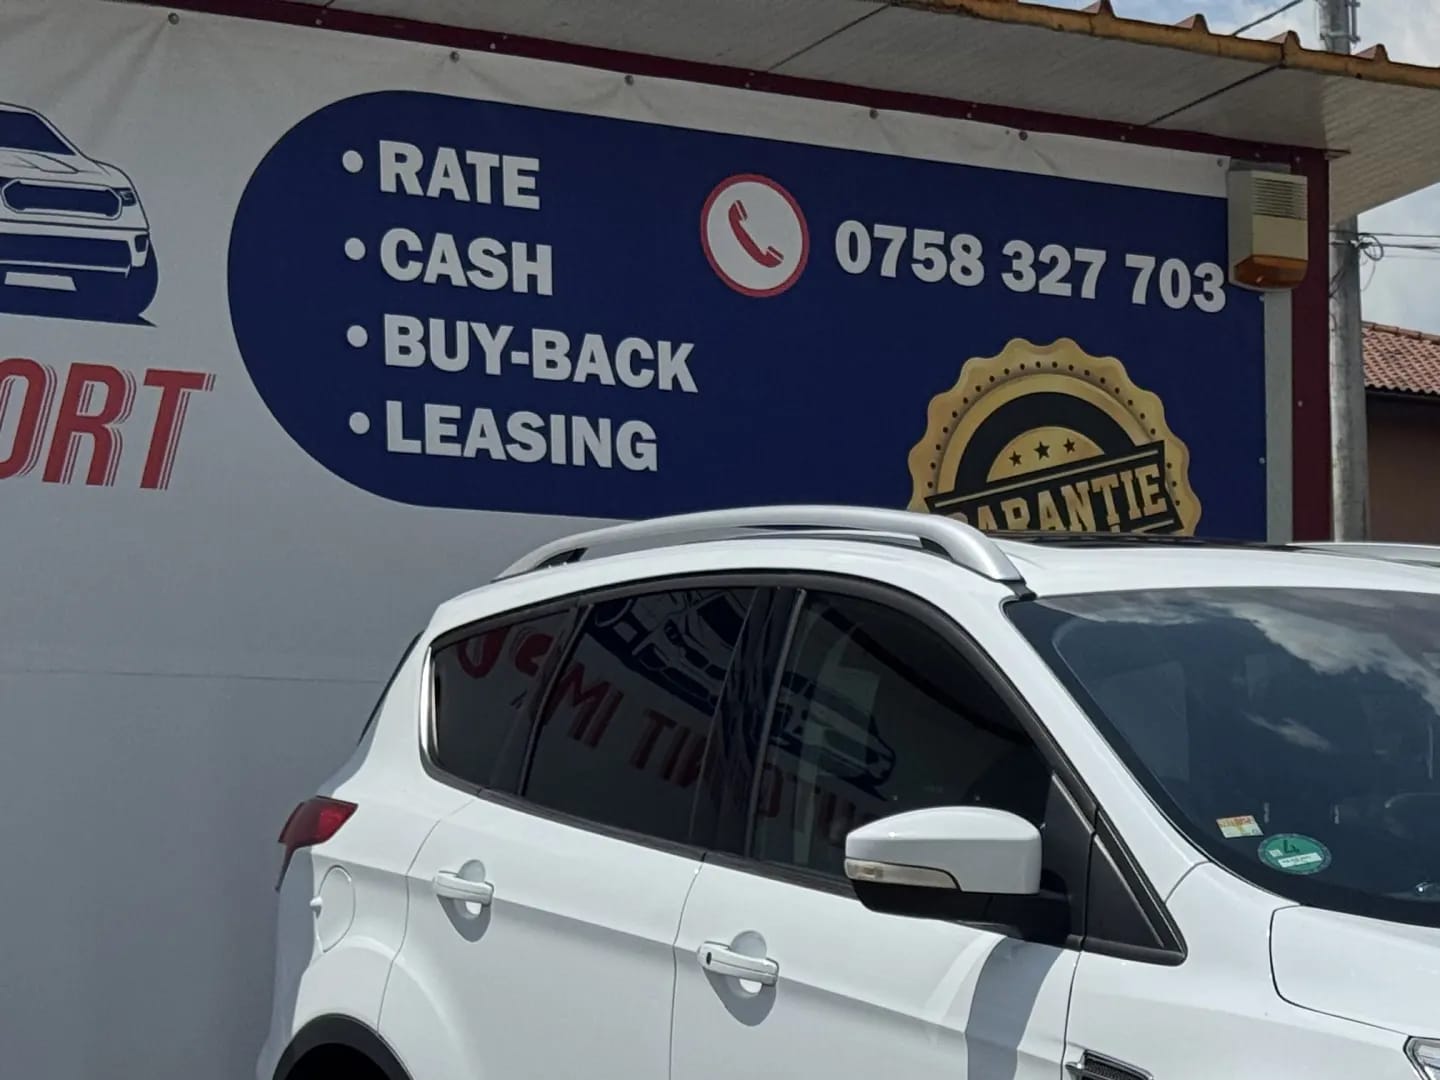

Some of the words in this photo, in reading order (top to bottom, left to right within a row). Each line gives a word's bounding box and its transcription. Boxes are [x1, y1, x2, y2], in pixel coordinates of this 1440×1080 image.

[379, 140, 540, 210] RATE
[380, 228, 553, 296] CASH
[835, 220, 985, 286] 0758
[1001, 239, 1106, 299] 327
[1125, 254, 1226, 313] 703
[384, 313, 698, 393] BUY-BACK
[386, 400, 657, 471] LEASING
